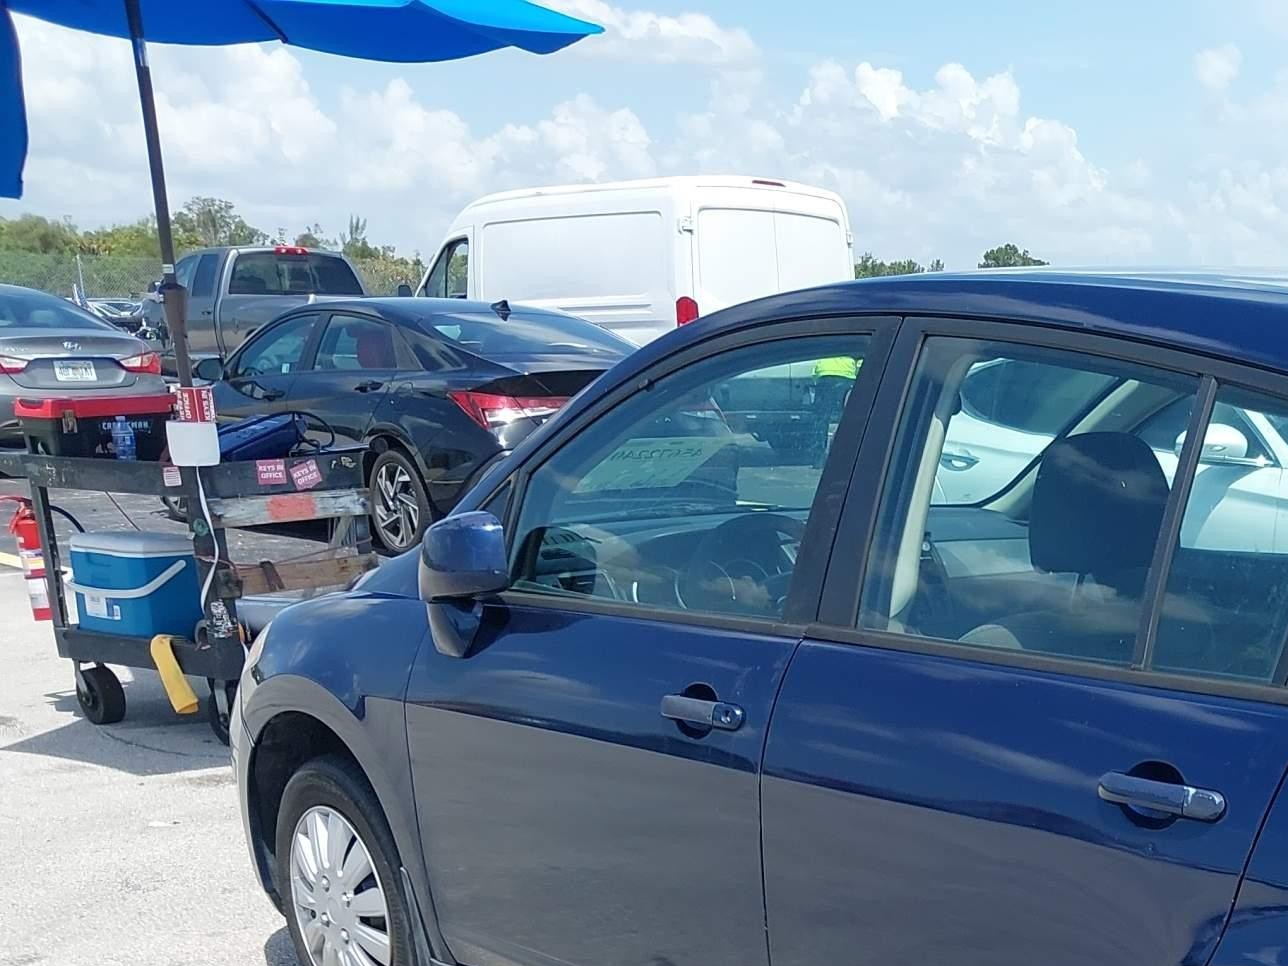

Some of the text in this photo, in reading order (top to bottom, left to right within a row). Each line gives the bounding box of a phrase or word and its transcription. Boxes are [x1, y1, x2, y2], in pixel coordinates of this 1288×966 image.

[183, 393, 192, 419] OFFICE
[201, 390, 211, 421] KEYS IN
[102, 420, 148, 430] CRASMAN
[293, 467, 309, 478] KEYS
[297, 471, 319, 484] OFFICE
